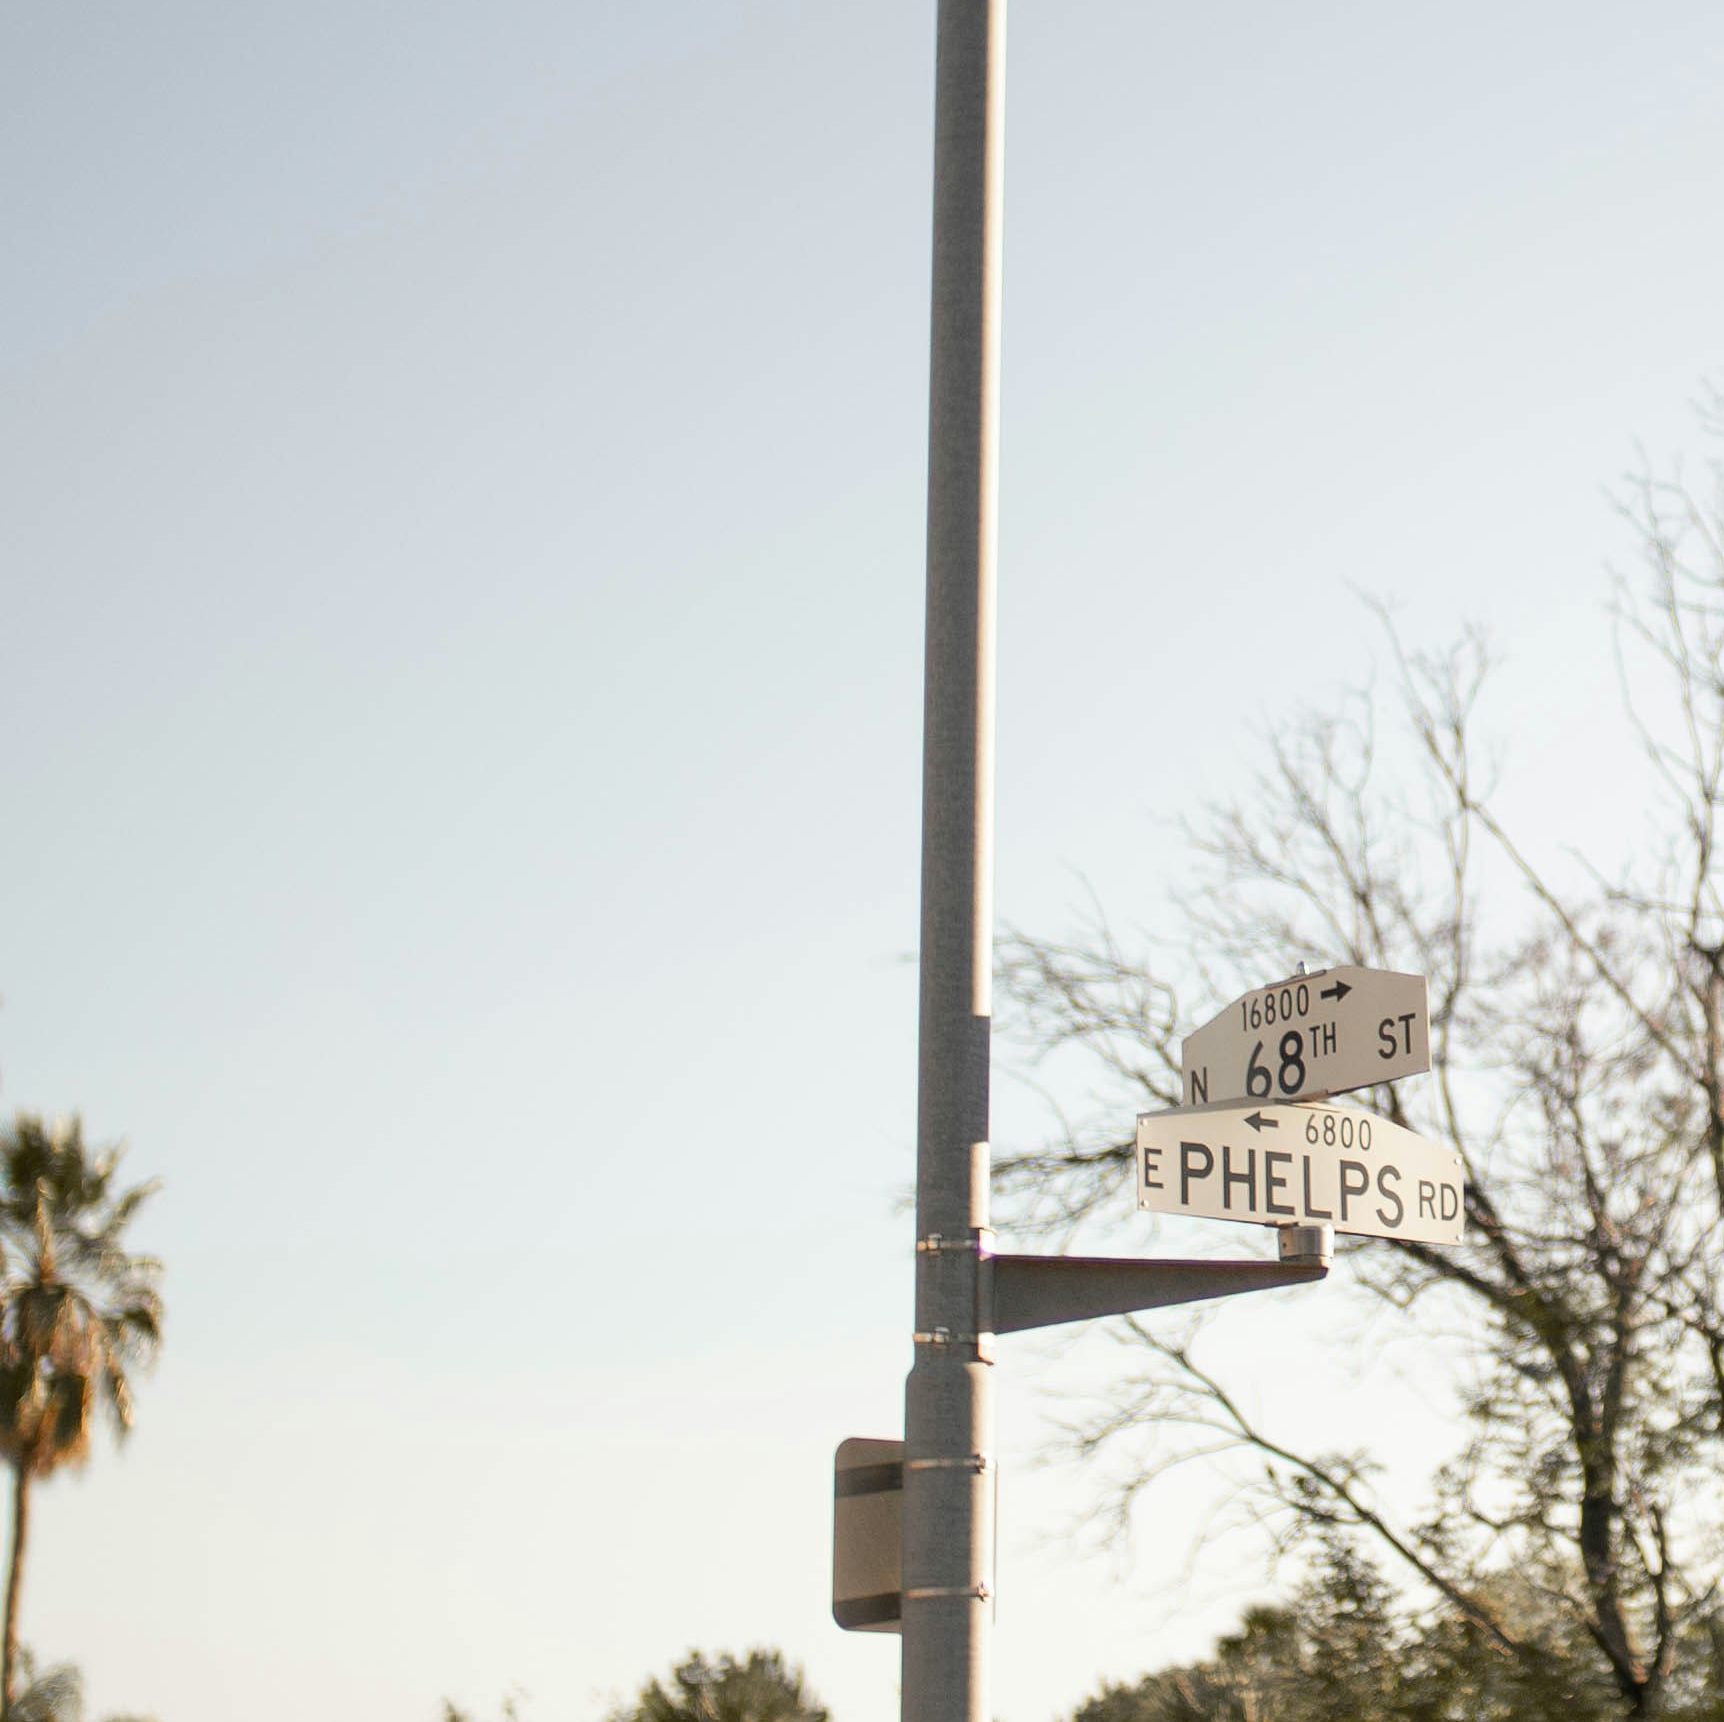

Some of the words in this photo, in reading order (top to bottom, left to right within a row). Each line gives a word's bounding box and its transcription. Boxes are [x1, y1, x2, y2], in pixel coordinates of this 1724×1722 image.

[1241, 983, 1310, 1032] 16800
[1190, 1066, 1208, 1105] N
[1377, 1012, 1416, 1060] ST
[1305, 1113, 1372, 1151] 6800
[1143, 1147, 1164, 1189] E
[1180, 1141, 1404, 1228] PHELPS
[1418, 1179, 1459, 1221] RD
